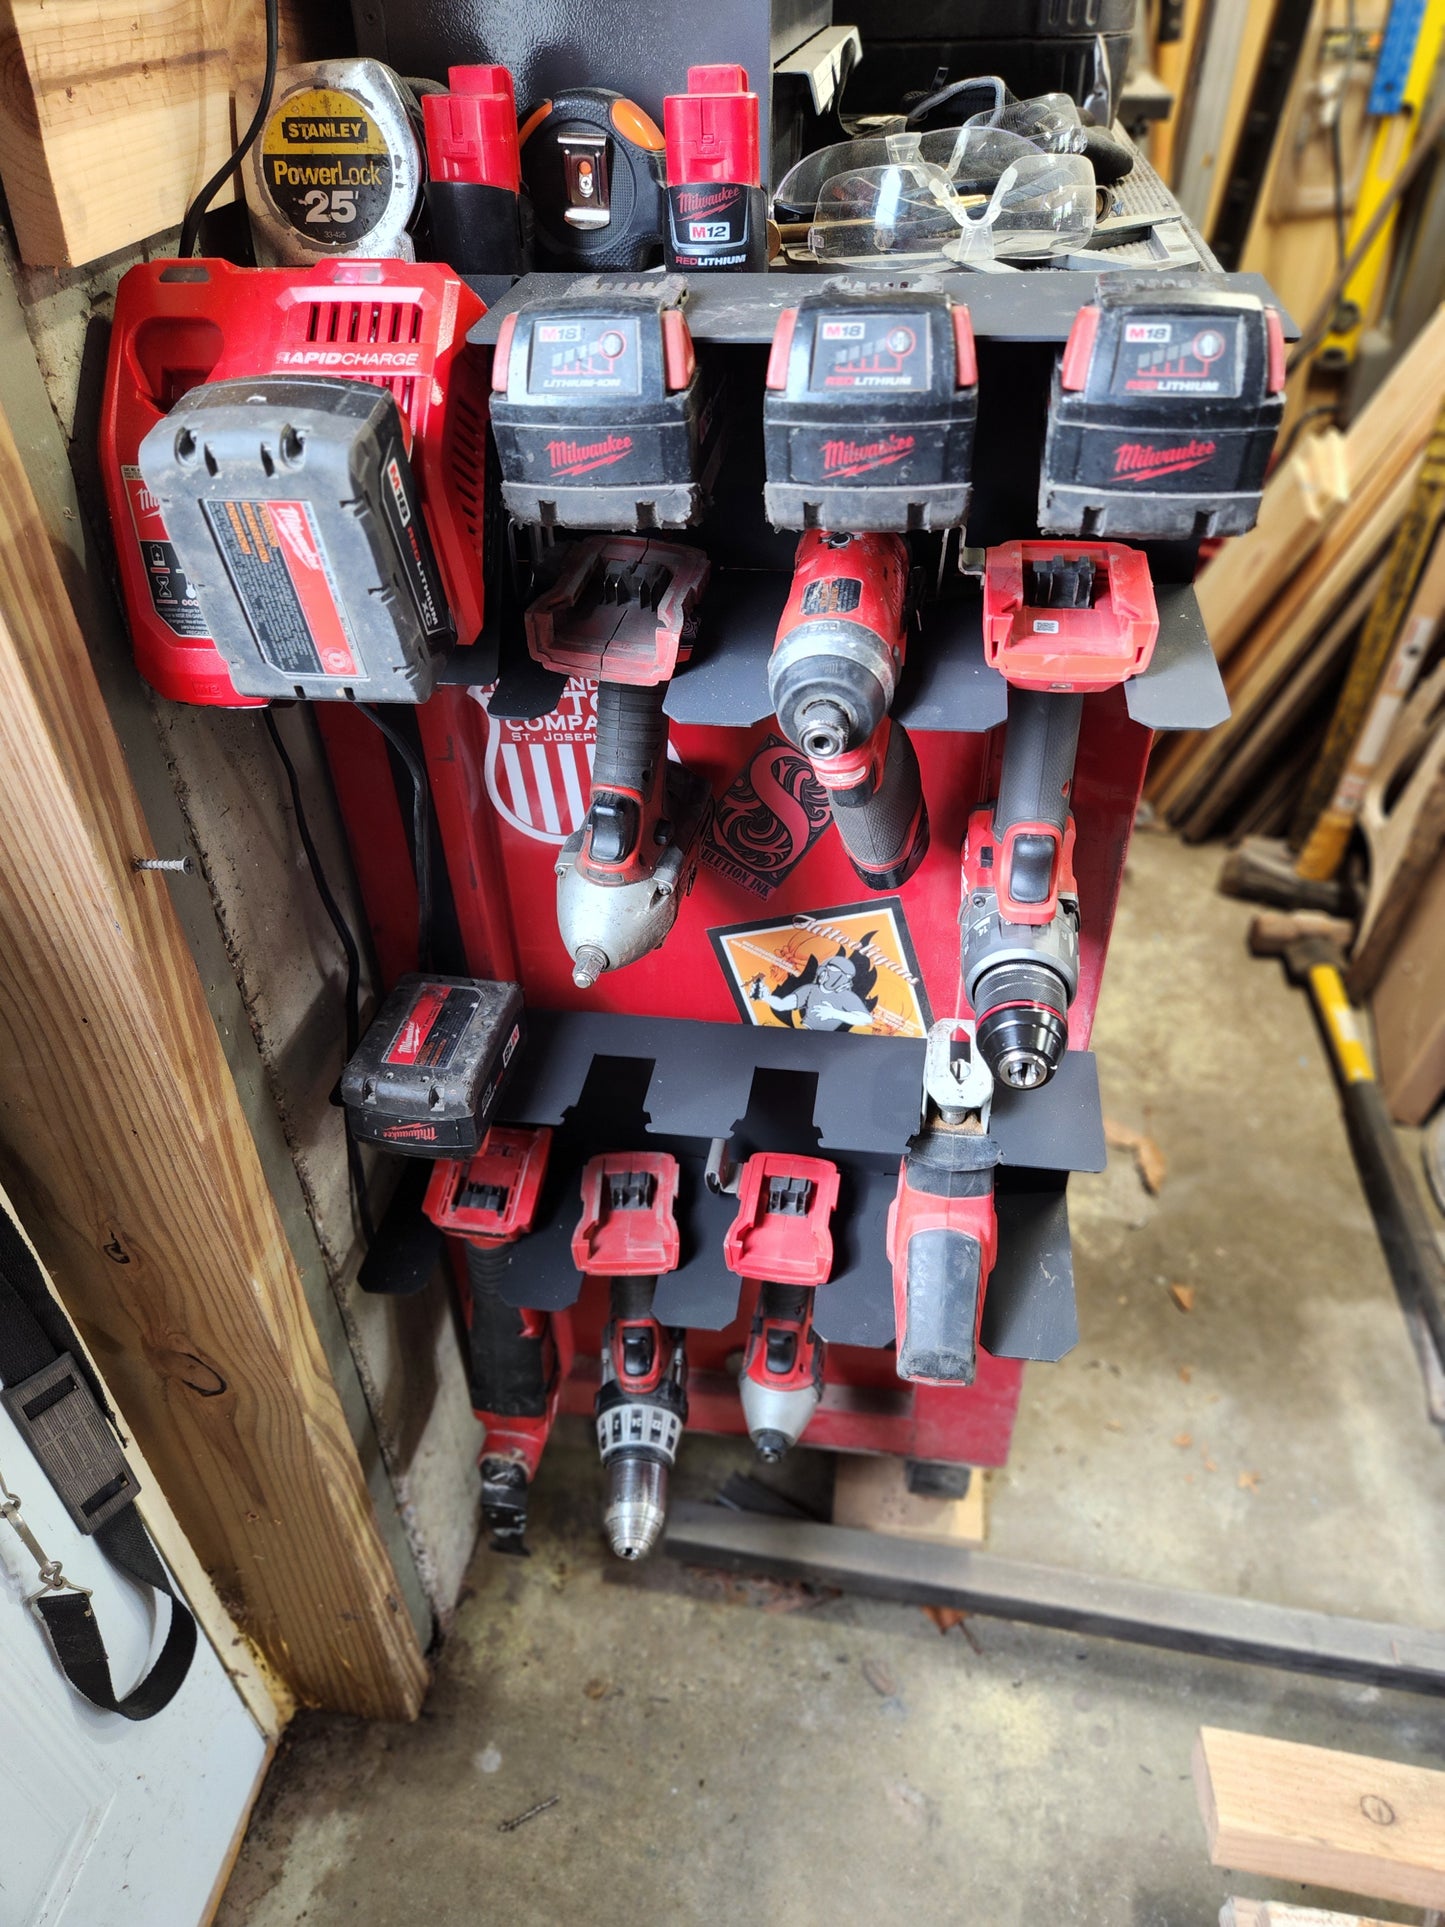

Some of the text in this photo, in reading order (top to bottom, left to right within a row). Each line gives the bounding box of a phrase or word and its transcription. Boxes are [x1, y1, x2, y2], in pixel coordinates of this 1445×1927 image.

[288, 123, 361, 138] STANLEY
[274, 160, 382, 185] PowerLock
[676, 186, 741, 214] Milwaukee
[692, 226, 726, 238] M12
[675, 254, 747, 266] REDLITHIUM
[541, 326, 578, 340] M18
[825, 324, 863, 338] M18
[1128, 327, 1167, 340] M18
[275, 351, 419, 366] RAPIDCHARGE
[825, 375, 913, 386] REDLITHIUM
[1125, 380, 1220, 392] REDLITHIUM
[544, 434, 633, 468] Milwaukee
[1113, 439, 1217, 472] Milwaukee
[389, 463, 408, 520] M18
[407, 525, 439, 626] REDLITHIUM
[505, 715, 598, 731] COMPA
[383, 1126, 439, 1141] Milwaukee
